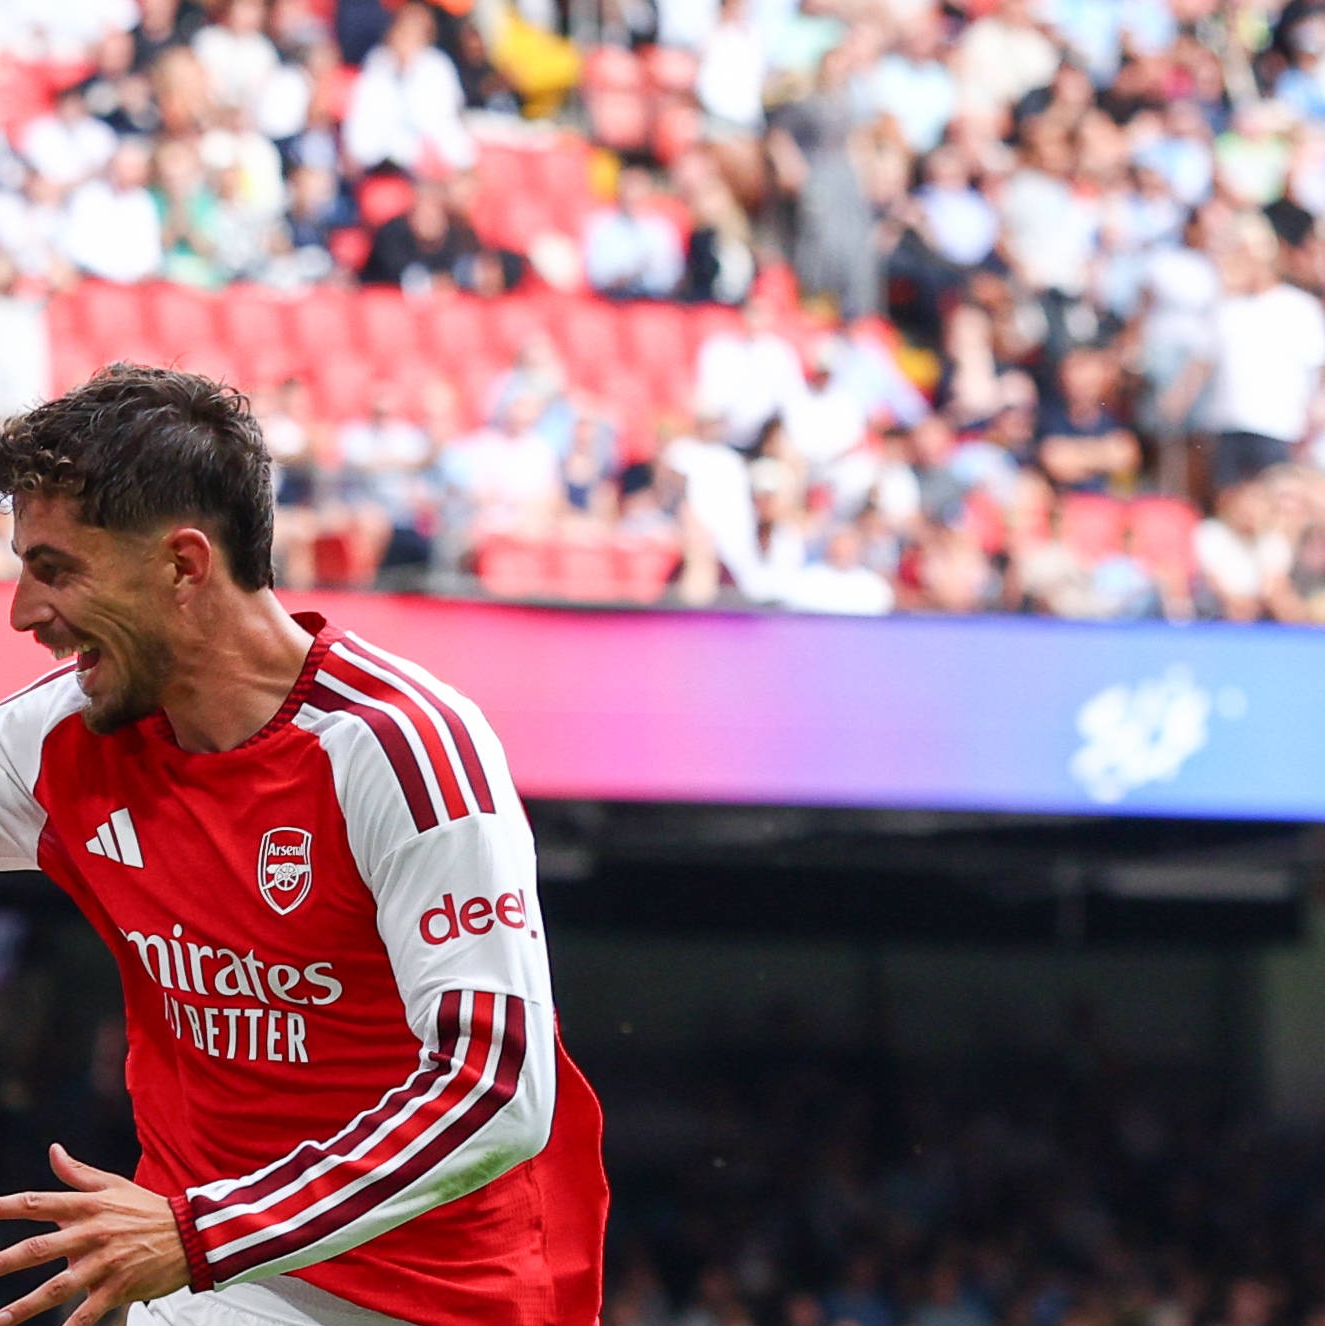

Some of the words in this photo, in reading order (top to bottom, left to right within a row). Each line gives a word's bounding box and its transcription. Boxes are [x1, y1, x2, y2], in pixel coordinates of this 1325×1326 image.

[268, 843, 305, 856] Arsenal
[119, 923, 343, 1005] mirates
[183, 1003, 309, 1063] BETTER
